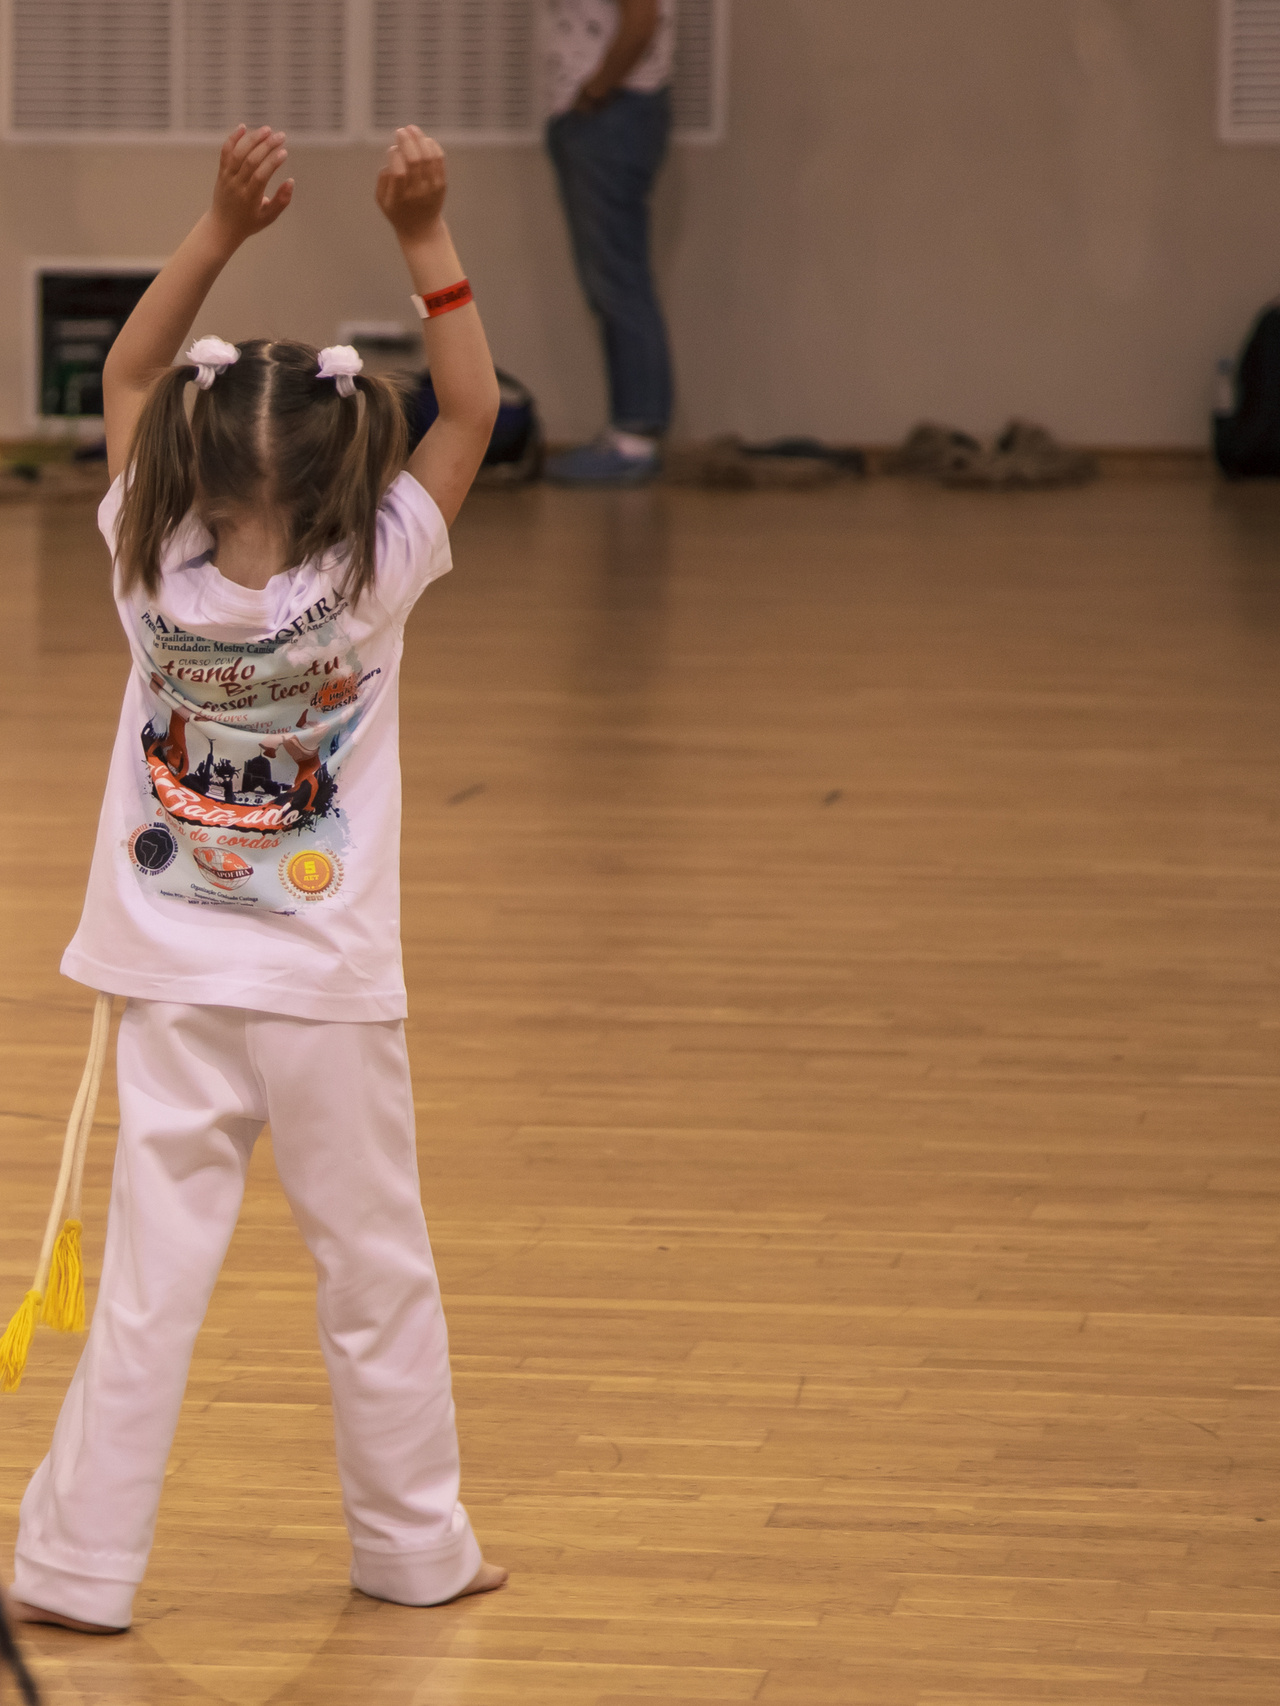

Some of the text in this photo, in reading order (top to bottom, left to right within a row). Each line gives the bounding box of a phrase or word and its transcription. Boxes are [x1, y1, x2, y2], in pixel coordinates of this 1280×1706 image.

[161, 642, 210, 652] Fundador:
[213, 641, 244, 653] Mestre
[159, 656, 256, 683] trando
[178, 658, 210, 666] CURSO
[197, 694, 258, 712] fessor
[190, 826, 210, 843] de
[216, 830, 283, 850] cordas
